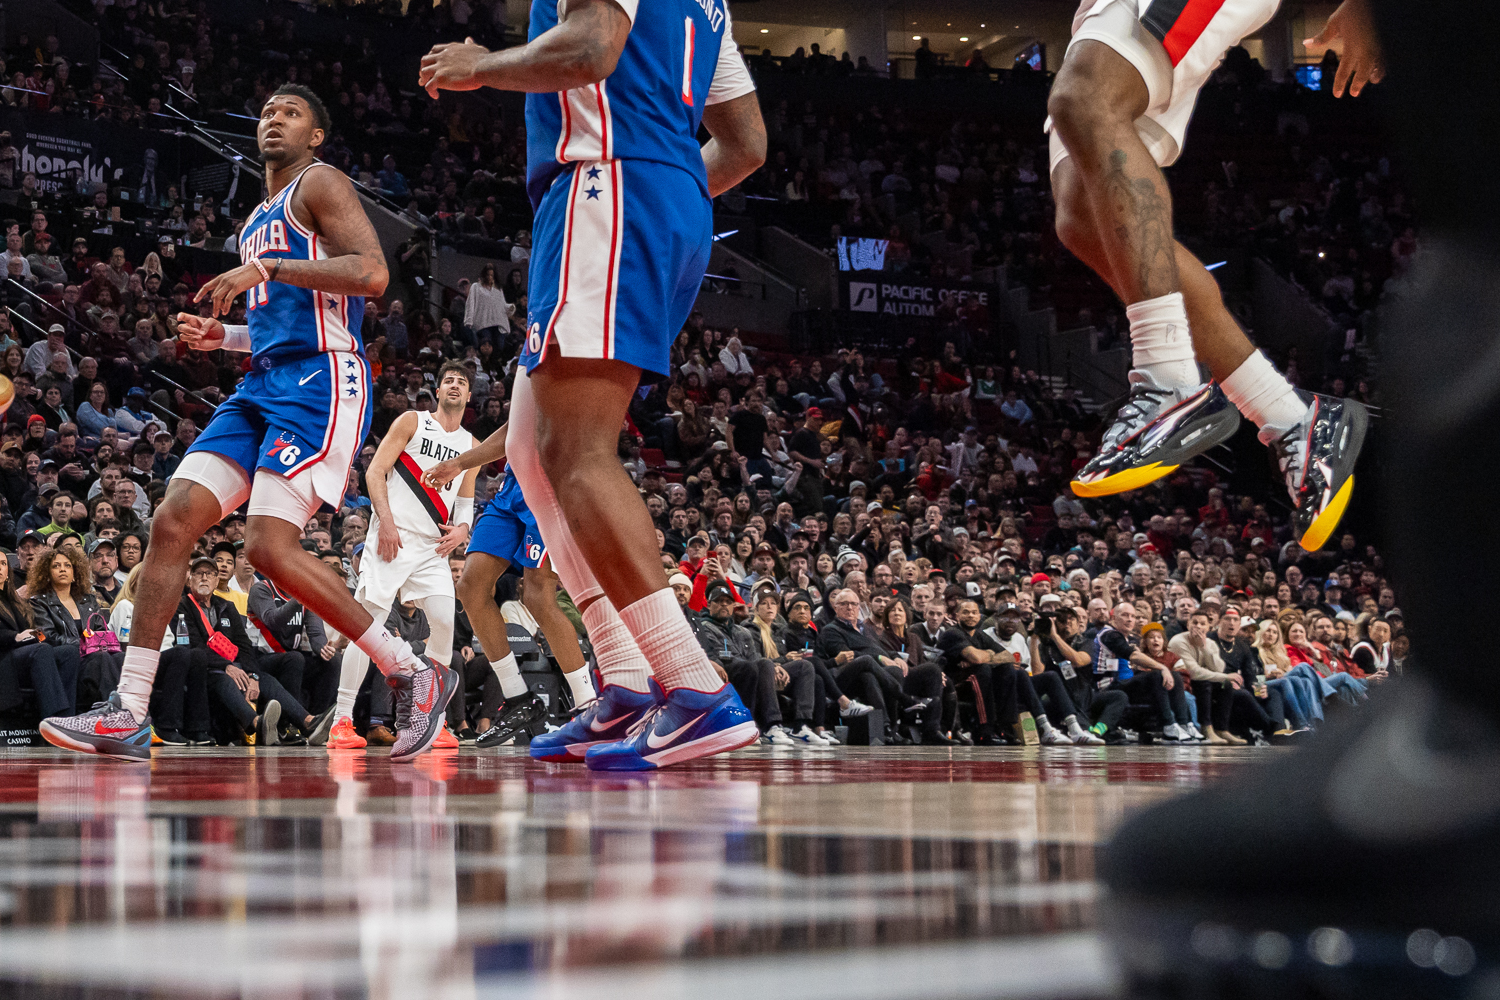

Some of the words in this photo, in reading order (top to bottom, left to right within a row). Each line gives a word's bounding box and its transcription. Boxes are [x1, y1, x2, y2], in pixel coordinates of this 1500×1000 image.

[681, 15, 696, 108] 1
[240, 219, 290, 266] PHILA
[881, 284, 933, 302] PACIFIC
[266, 437, 301, 466] 76
[525, 543, 541, 561] 76
[6, 737, 32, 745] CASINO
